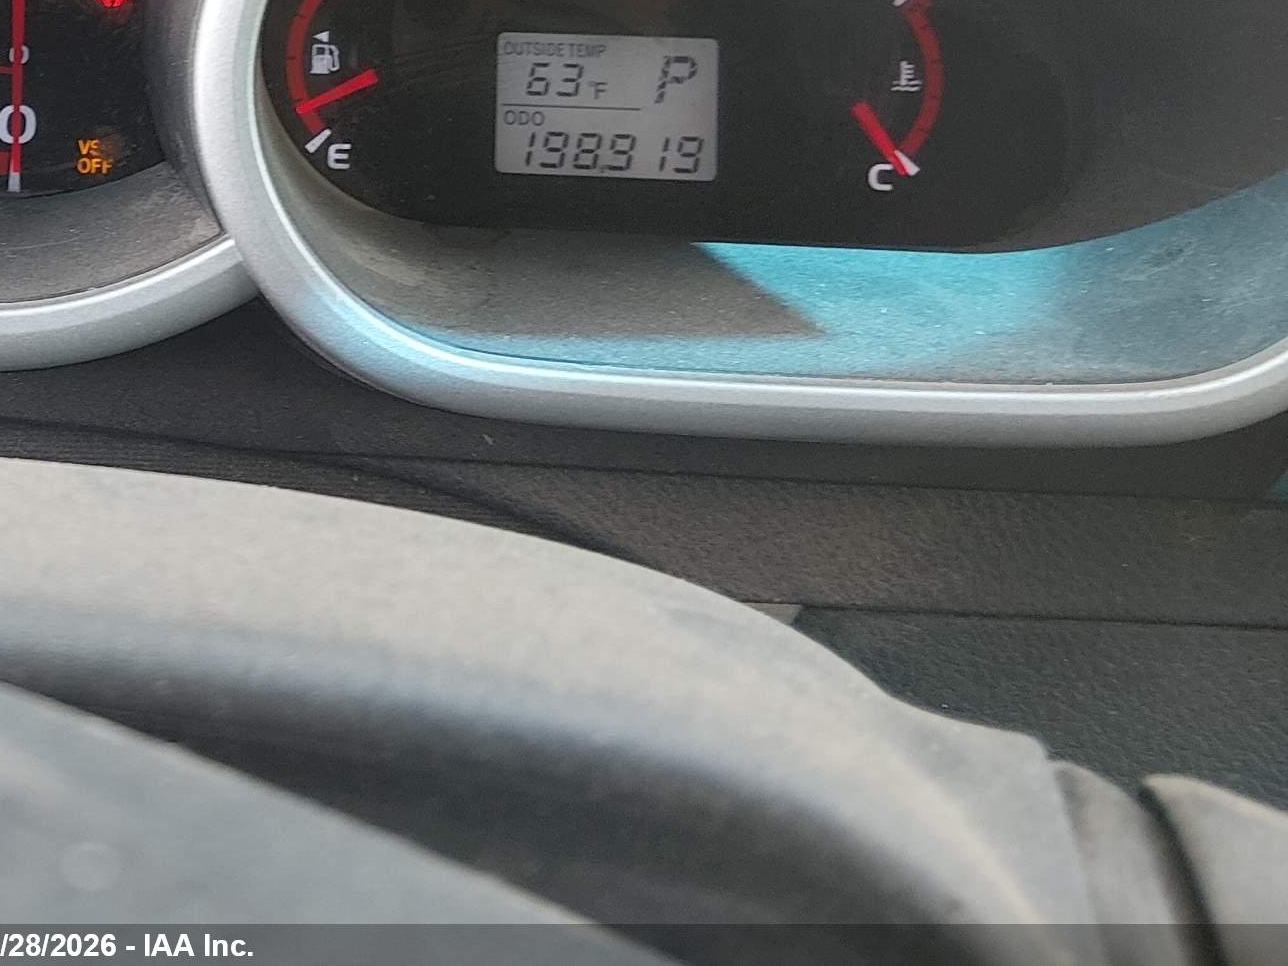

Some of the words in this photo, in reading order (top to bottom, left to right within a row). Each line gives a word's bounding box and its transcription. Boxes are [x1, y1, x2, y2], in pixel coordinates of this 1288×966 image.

[504, 41, 565, 57] OUTSIDE
[569, 44, 607, 58] TEMP
[526, 62, 584, 97] 63
[654, 55, 698, 104] P
[503, 111, 546, 126] ODO
[76, 157, 113, 174] OFF
[327, 143, 352, 170] E
[525, 131, 704, 174] 198919
[867, 163, 894, 191] C
